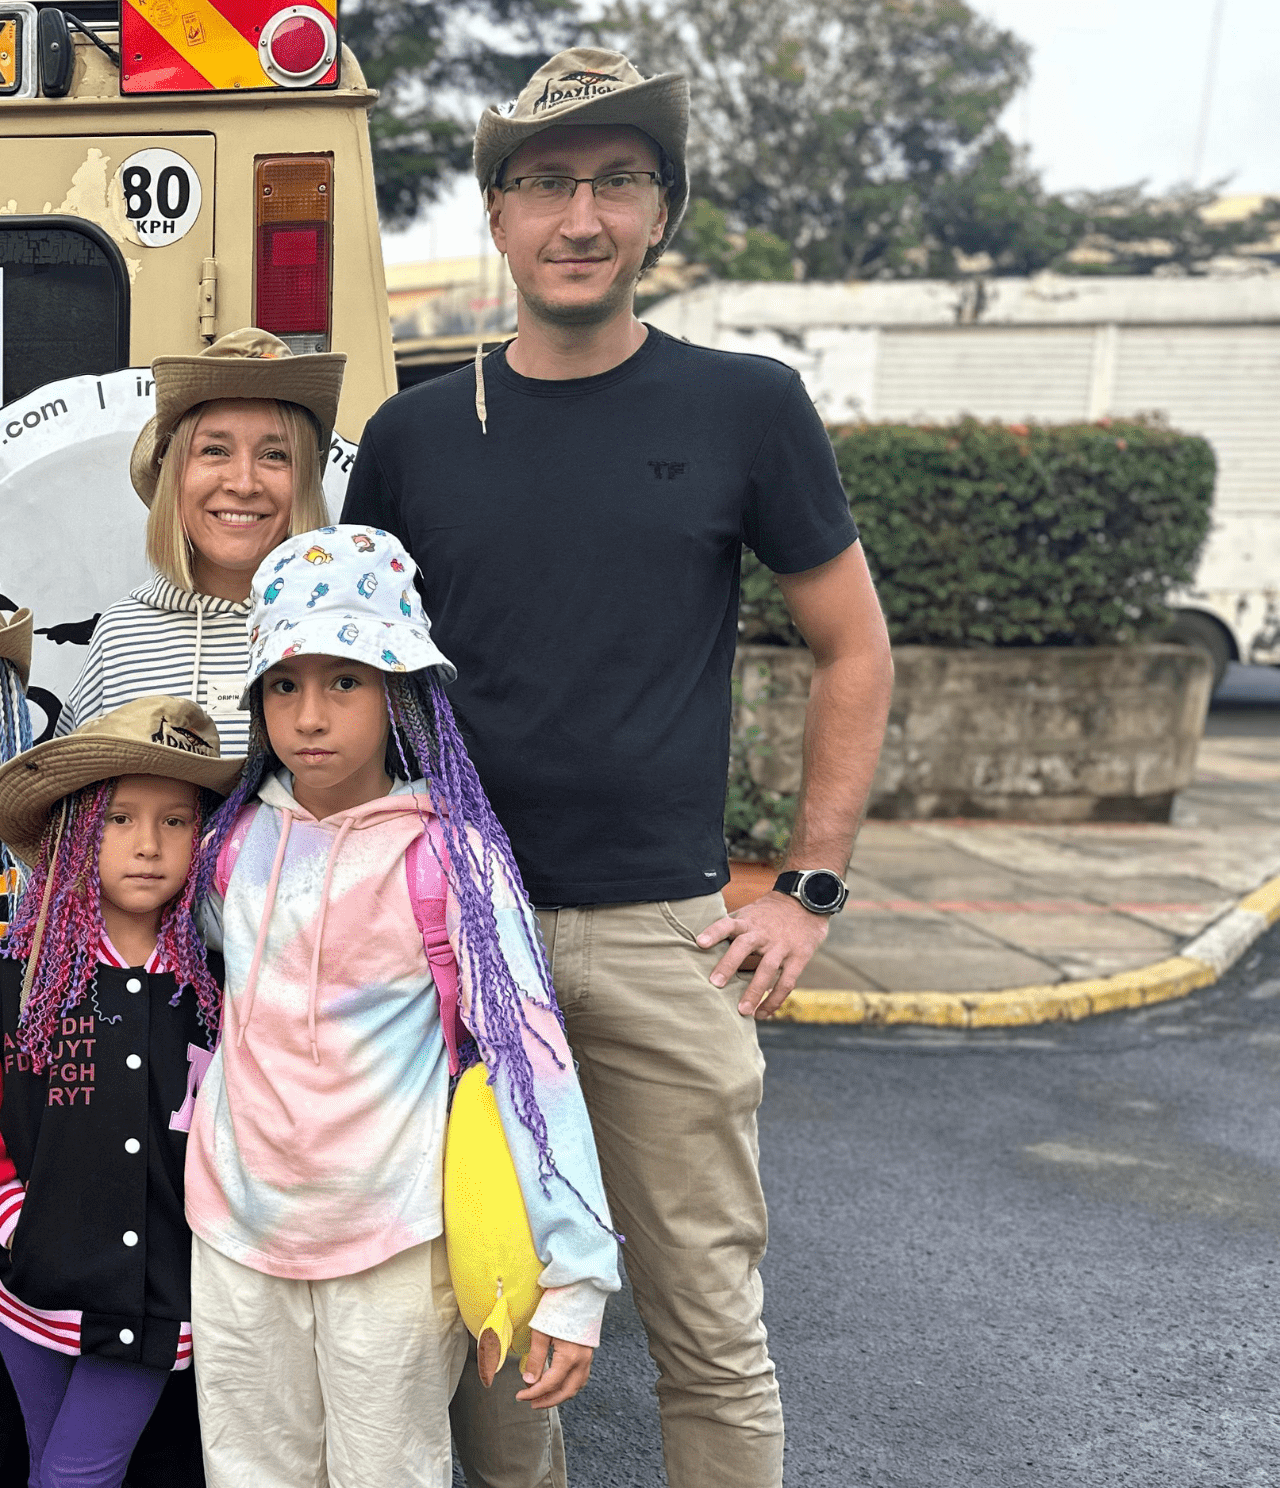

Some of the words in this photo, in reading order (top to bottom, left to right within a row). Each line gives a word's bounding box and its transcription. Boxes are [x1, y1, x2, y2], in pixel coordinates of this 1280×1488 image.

[122, 166, 190, 219] 80
[136, 220, 176, 234] KPH
[646, 460, 686, 480] TF
[49, 1062, 95, 1084] FGH
[48, 1086, 95, 1107] RYT
